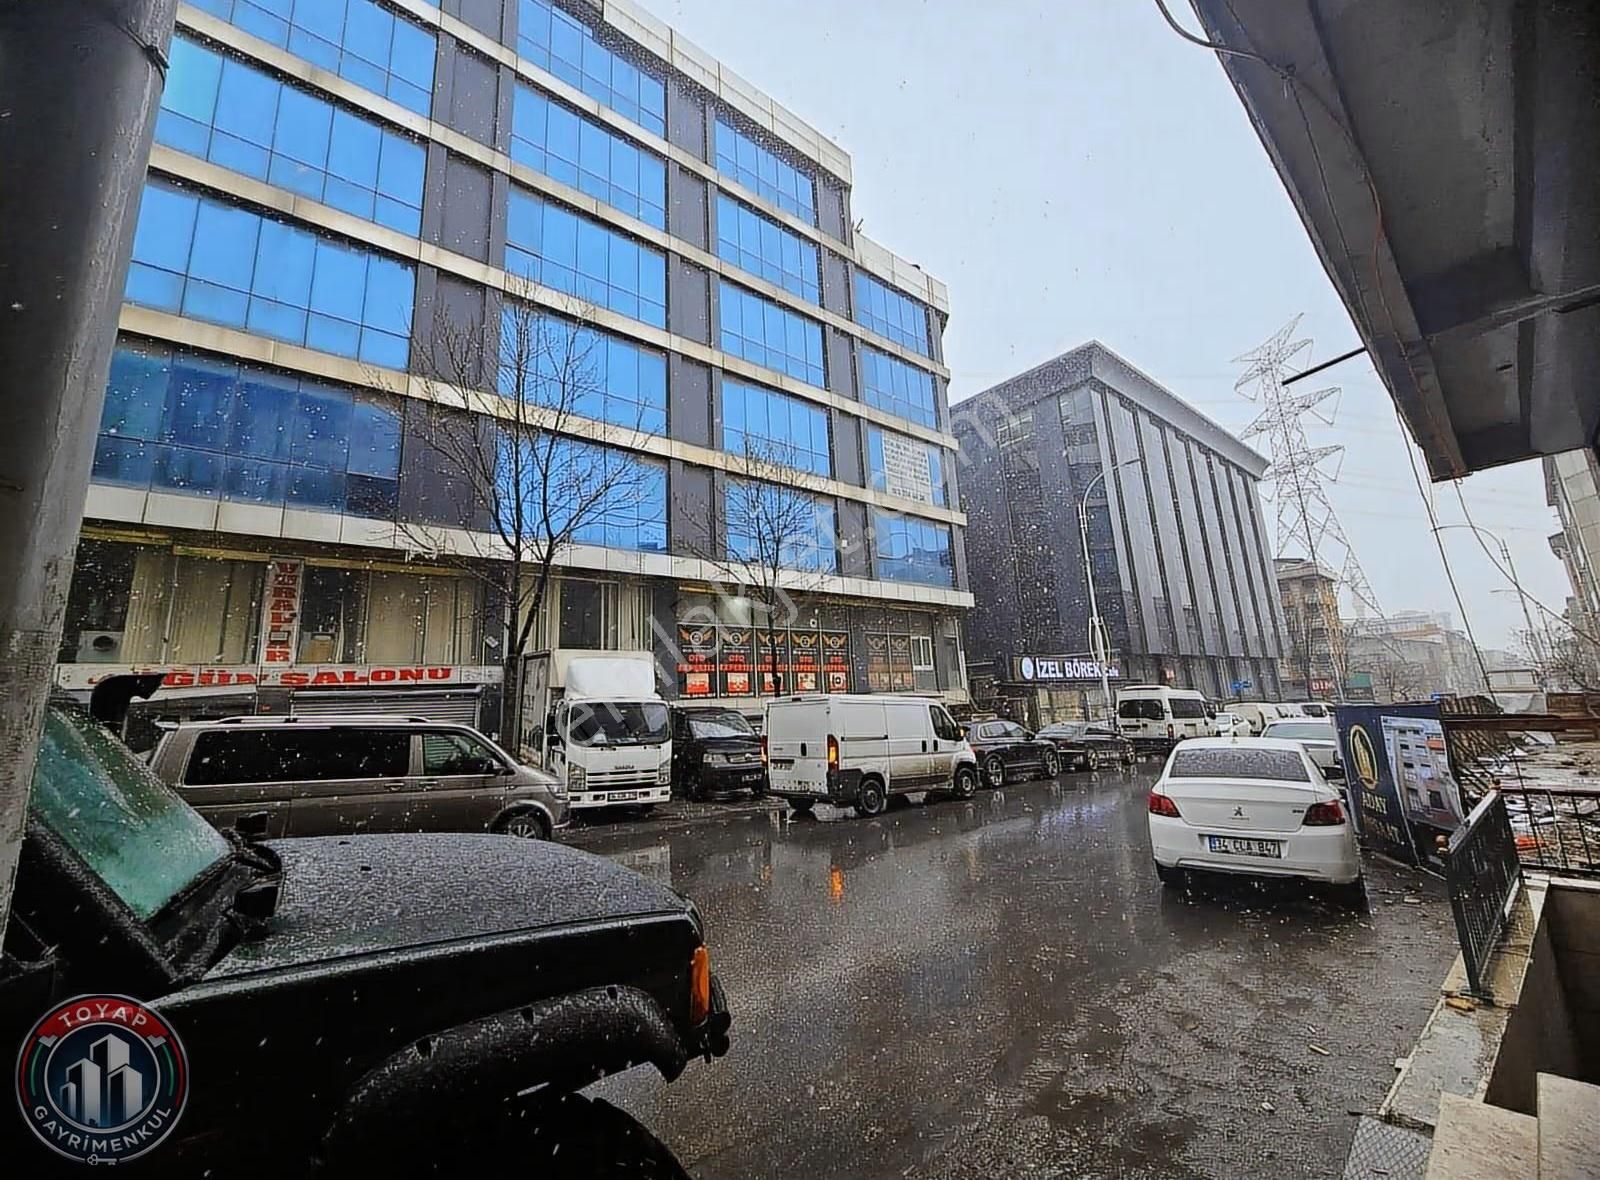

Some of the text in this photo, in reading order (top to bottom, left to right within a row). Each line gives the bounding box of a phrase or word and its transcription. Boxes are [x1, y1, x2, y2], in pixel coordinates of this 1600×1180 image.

[280, 667, 453, 686] SALONU
[1035, 657, 1064, 679] İZEL
[1064, 658, 1102, 679] BÖREK
[1217, 838, 1228, 849] 34
[1233, 840, 1253, 851] CLA
